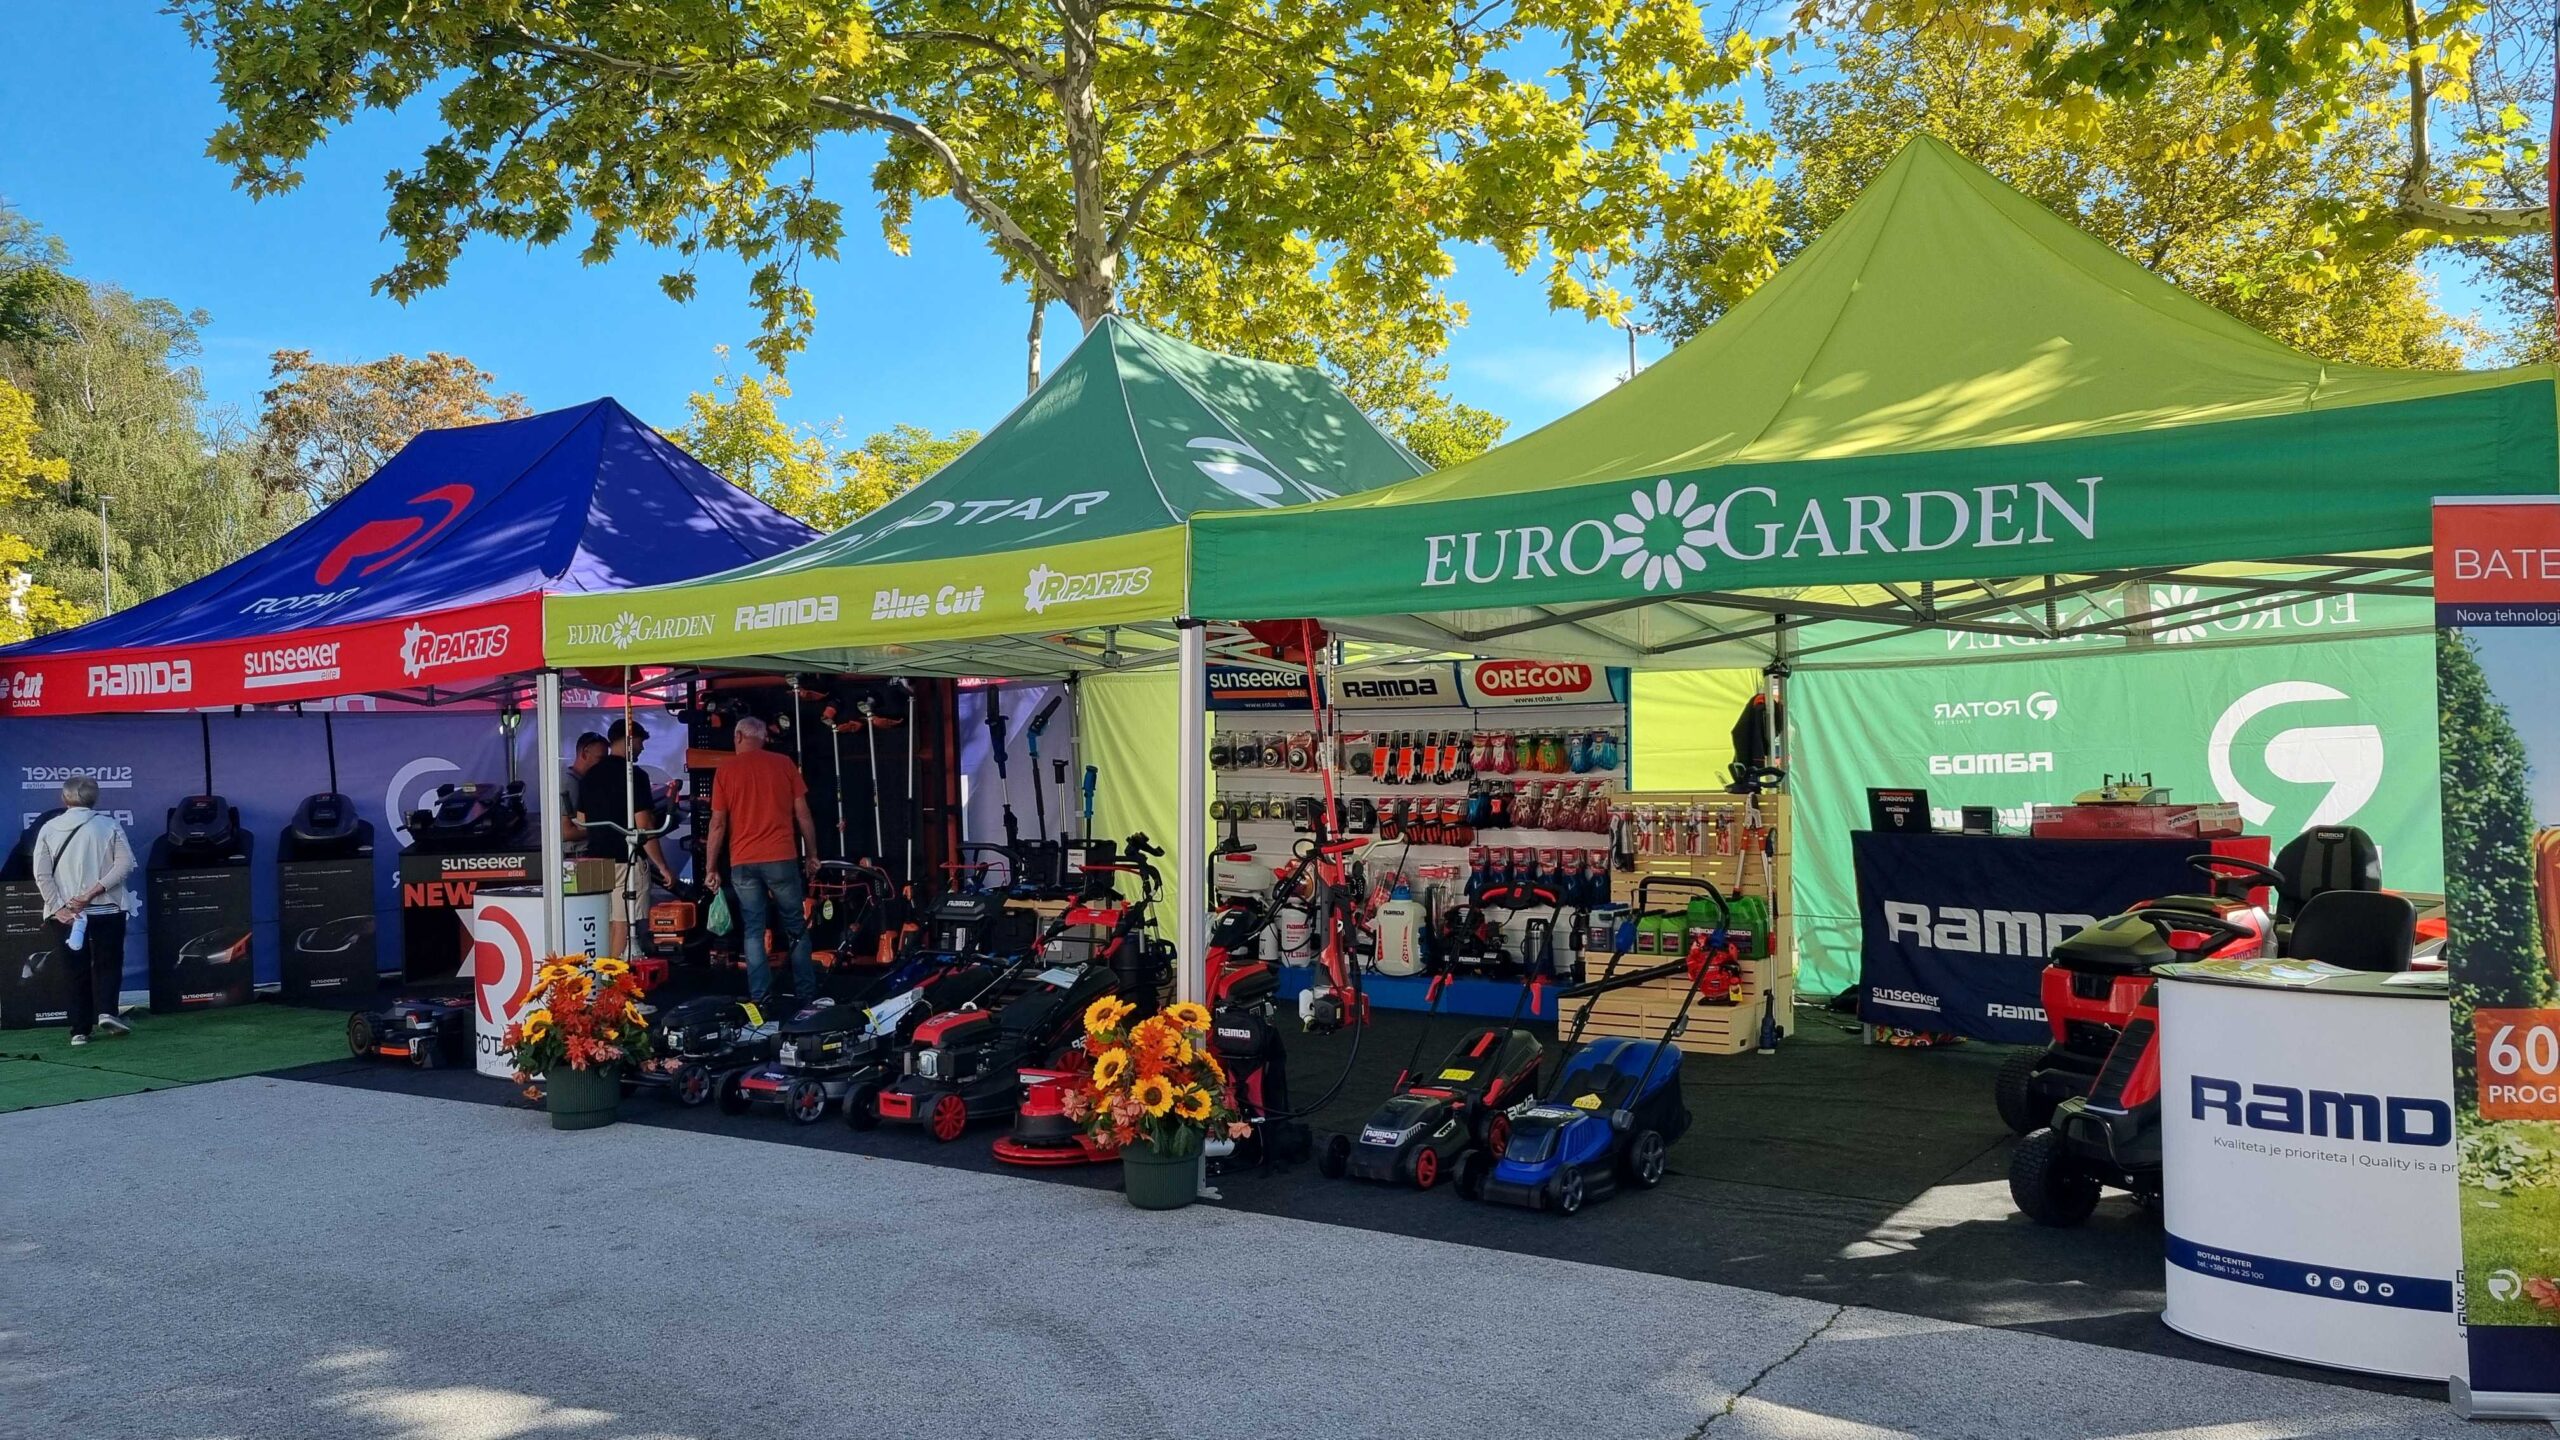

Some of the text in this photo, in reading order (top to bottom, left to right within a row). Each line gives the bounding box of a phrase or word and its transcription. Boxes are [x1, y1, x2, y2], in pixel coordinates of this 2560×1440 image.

[1420, 476, 2104, 586] EURO GARDEN
[239, 586, 360, 614] ROTAR
[871, 585, 984, 621] Blue Cut
[2456, 609, 2491, 622] Nova
[567, 614, 716, 646] EURO GARDEN
[244, 641, 341, 675] sunseeker
[12, 671, 44, 699] Cut
[1481, 666, 1582, 690] OREGON
[12, 699, 41, 708] CANADA
[441, 856, 526, 871] sunseeker
[404, 881, 478, 908] NEW
[1872, 986, 1940, 1007] sunseeker
[2488, 1084, 2560, 1105] PROG
[2213, 1136, 2267, 1154] Kvaliteta
[2270, 1144, 2282, 1156] je
[2285, 1147, 2348, 1165] prioriteta
[2358, 1154, 2411, 1172] Quality
[2414, 1159, 2425, 1171] is
[2428, 1162, 2437, 1172] a
[2221, 1256, 2252, 1269] CENTER
